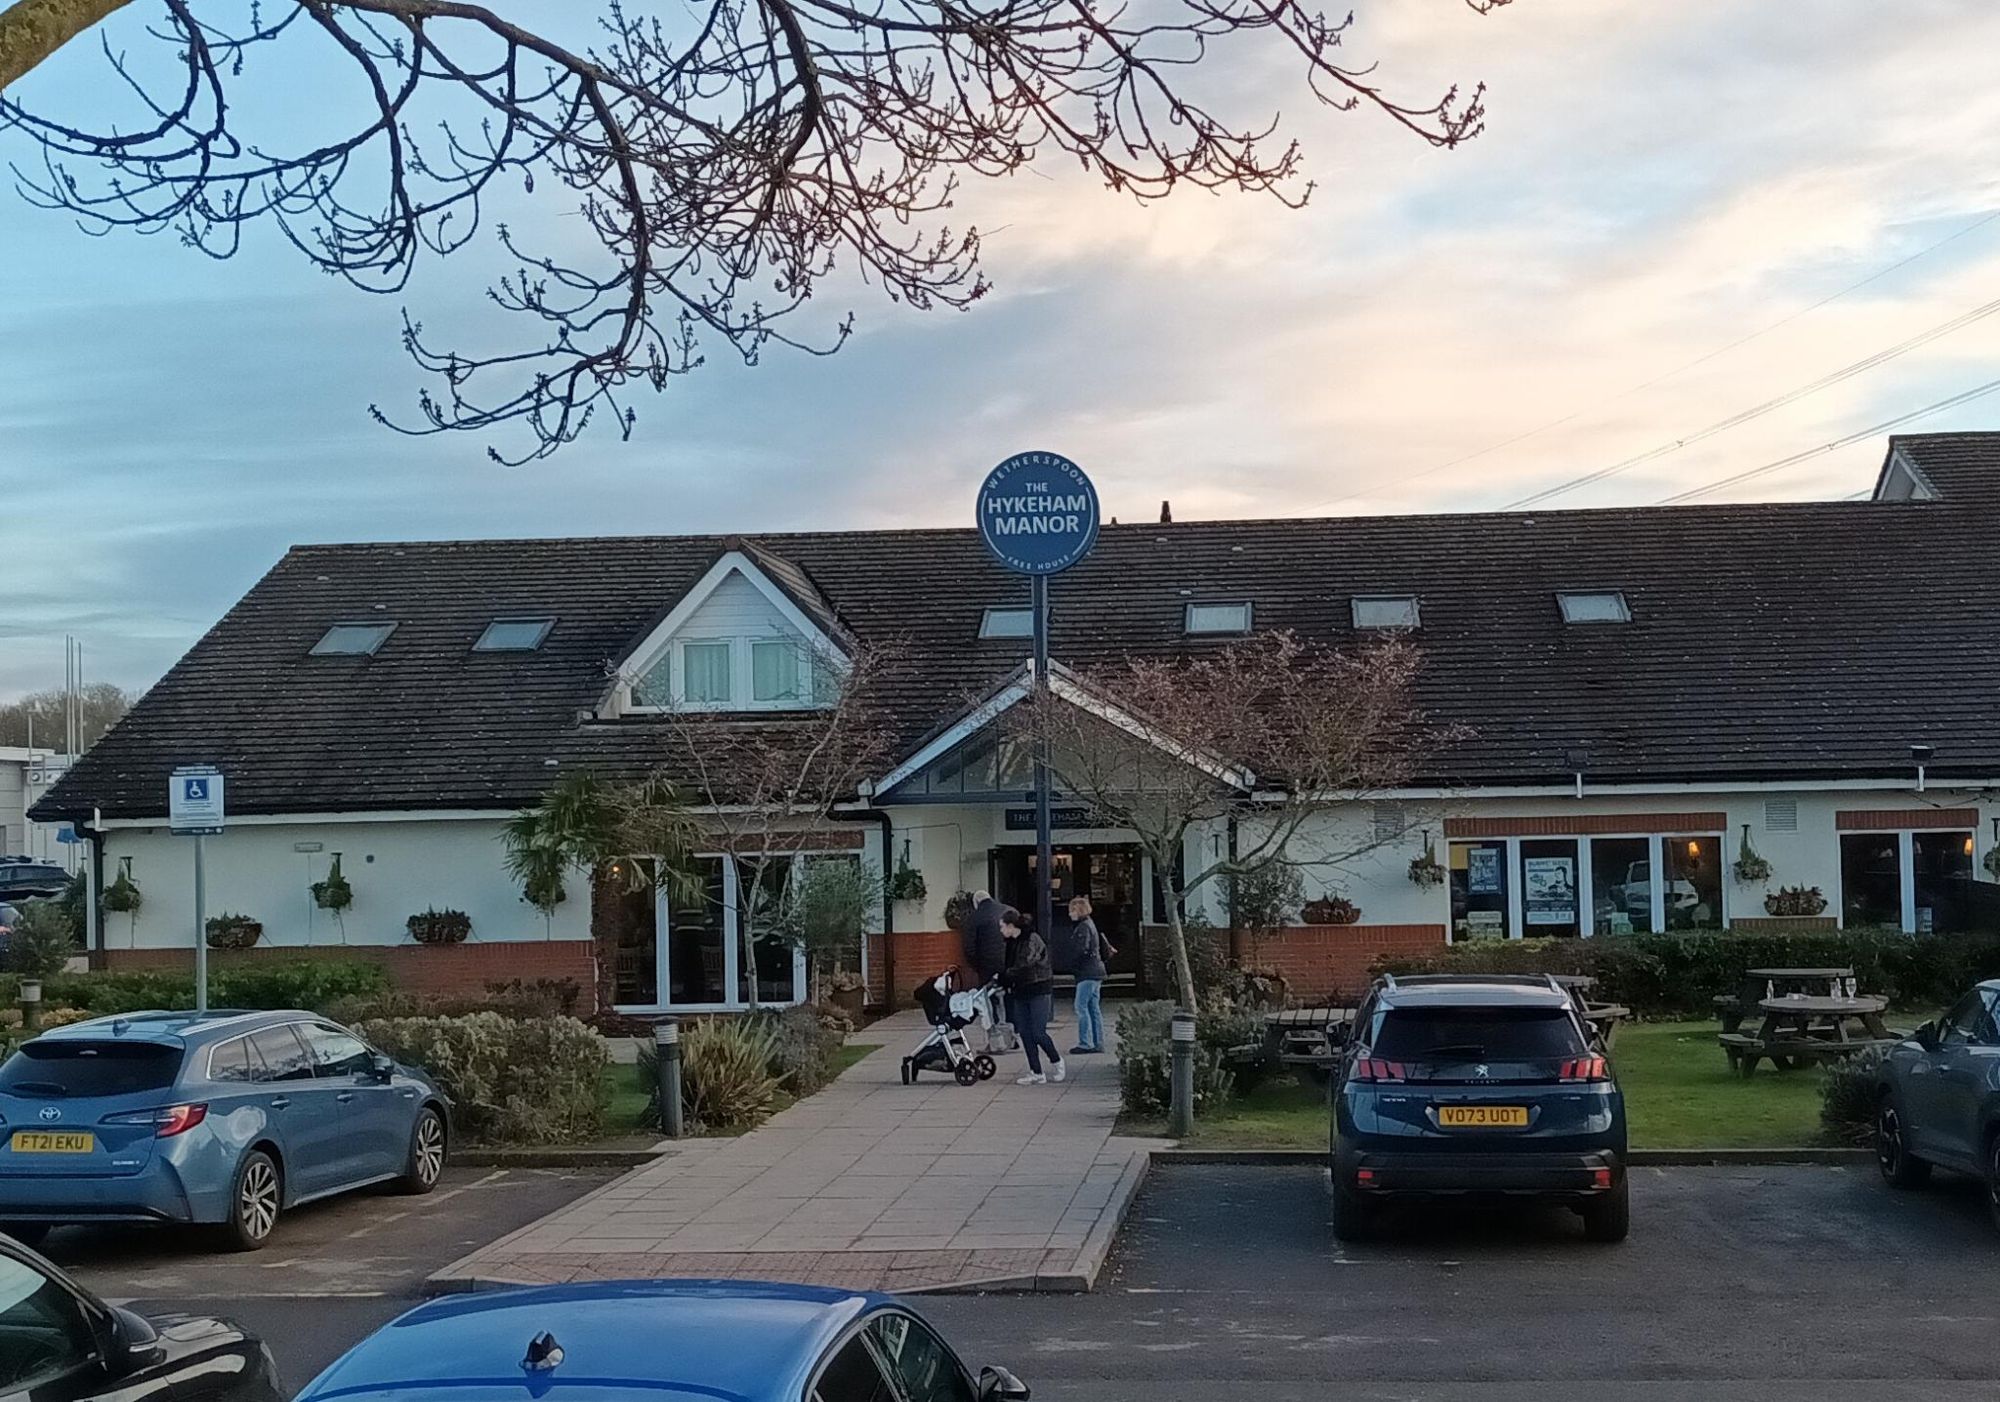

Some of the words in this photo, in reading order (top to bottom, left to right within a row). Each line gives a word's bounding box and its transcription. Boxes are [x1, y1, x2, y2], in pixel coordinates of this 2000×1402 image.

[988, 455, 1086, 489] WETHERSPOON
[1025, 482, 1048, 493] THE
[987, 494, 1087, 514] HYKEHAM
[995, 515, 1080, 535] MANOR
[1007, 556, 1031, 570] FREE
[1037, 555, 1070, 570] HOUSE
[1445, 1109, 1485, 1123] VO73
[1490, 1109, 1520, 1123] UOT
[20, 1134, 52, 1150] FT21
[55, 1134, 85, 1150] EKU
